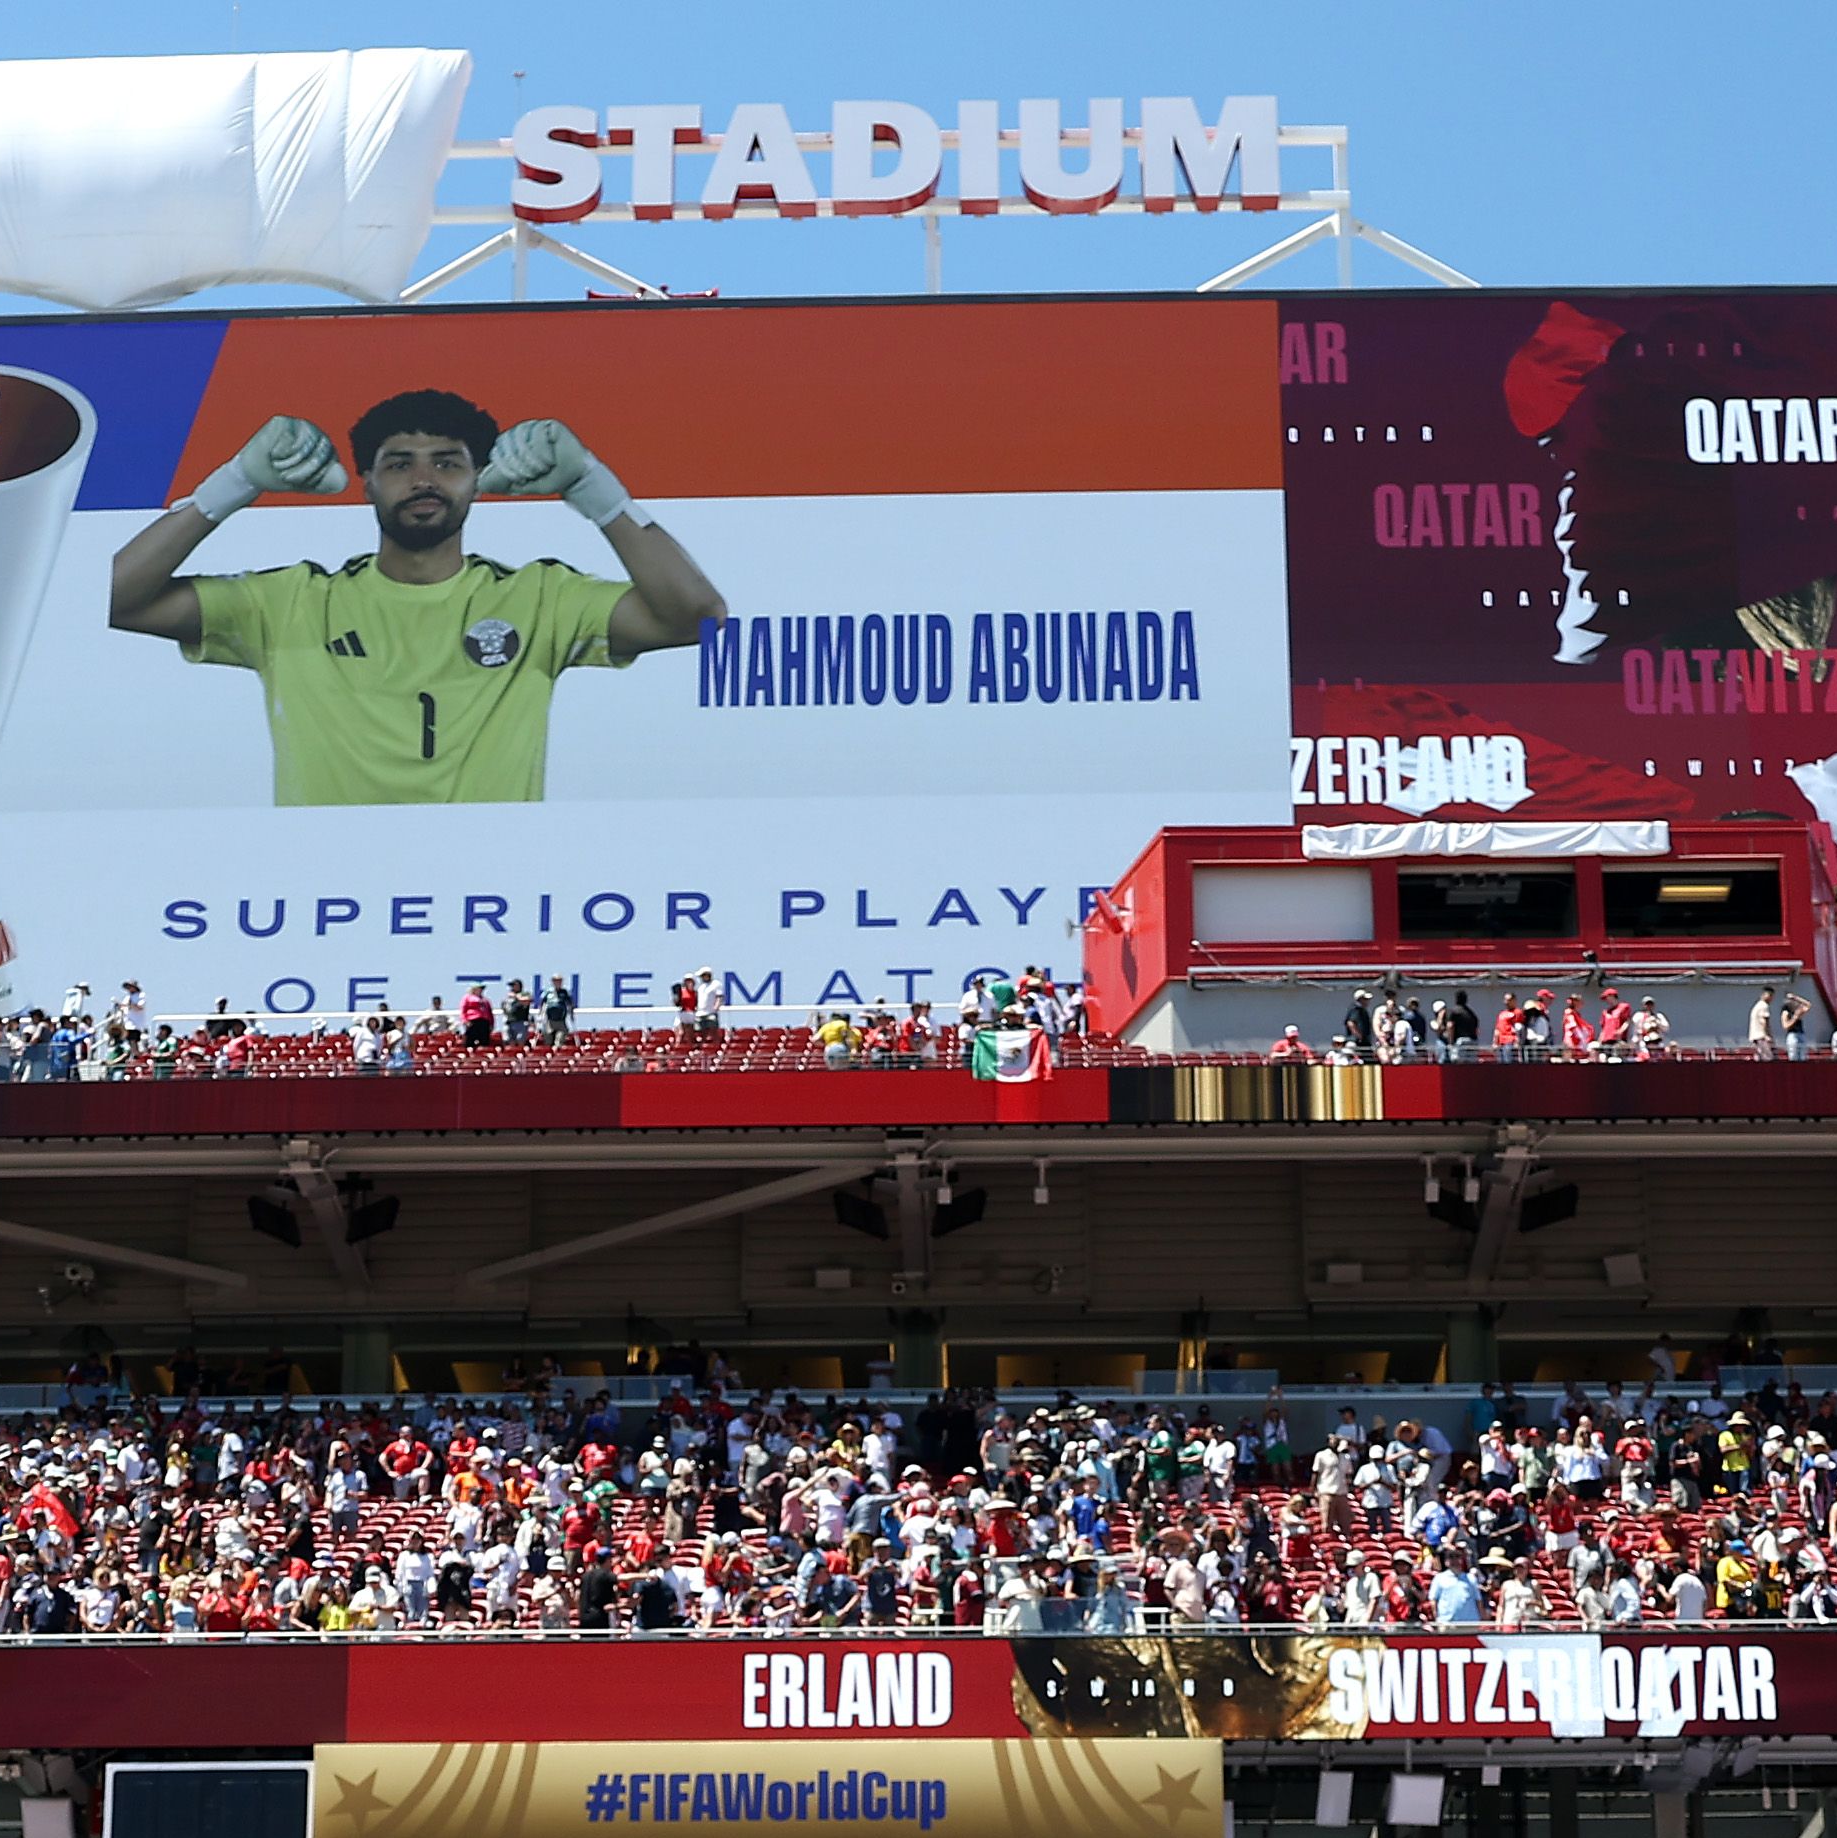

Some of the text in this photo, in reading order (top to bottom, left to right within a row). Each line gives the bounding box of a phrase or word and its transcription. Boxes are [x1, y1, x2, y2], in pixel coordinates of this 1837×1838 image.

[511, 95, 1280, 222] STADIUM
[1280, 322, 1348, 384] AR
[1373, 483, 1543, 548] QATAR
[699, 611, 1199, 707] MAHMOUD ABUNADA
[419, 691, 437, 760] 1
[162, 892, 711, 939] SUPERIOR
[263, 975, 390, 1014] OF
[456, 971, 654, 1010] THE
[742, 1651, 952, 1730] ERLAND
[585, 1767, 947, 1831] #FIFAWorldCup
